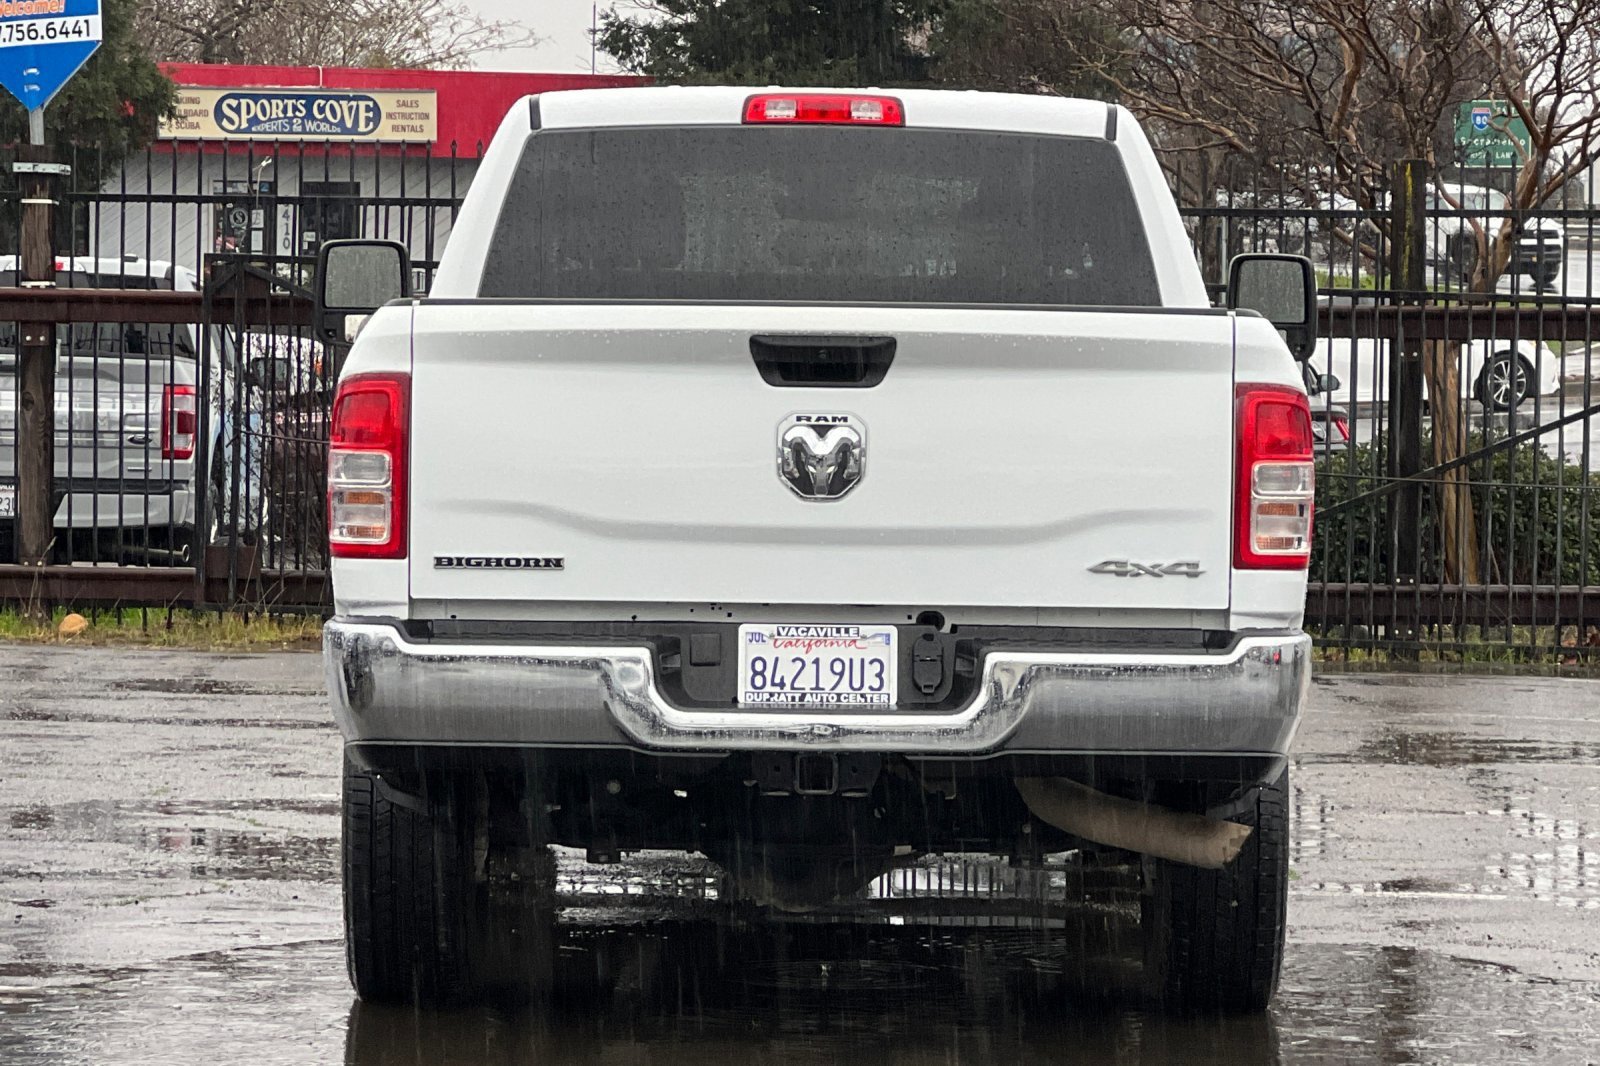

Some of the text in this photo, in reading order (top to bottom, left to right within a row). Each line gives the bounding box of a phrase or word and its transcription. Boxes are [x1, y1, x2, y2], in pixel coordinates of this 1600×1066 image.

[176, 96, 201, 105] KIING
[396, 99, 420, 108] SALES
[221, 98, 374, 132] SPORTS COVE
[385, 111, 430, 120] INSTRUCTION
[1475, 115, 1488, 125] 80
[175, 121, 201, 130] SCUBA
[391, 124, 425, 133] RENTALS
[1460, 136, 1526, 146] Scraeo
[1495, 151, 1517, 159] LAN
[795, 415, 848, 423] RAM
[433, 556, 565, 570] BIGHORN
[777, 626, 859, 638] VACAVILLE
[748, 632, 767, 643] JUL
[773, 638, 868, 655] California
[750, 656, 885, 692] 84219U3
[803, 693, 838, 704] AUTO
[840, 693, 889, 704] CENTER
